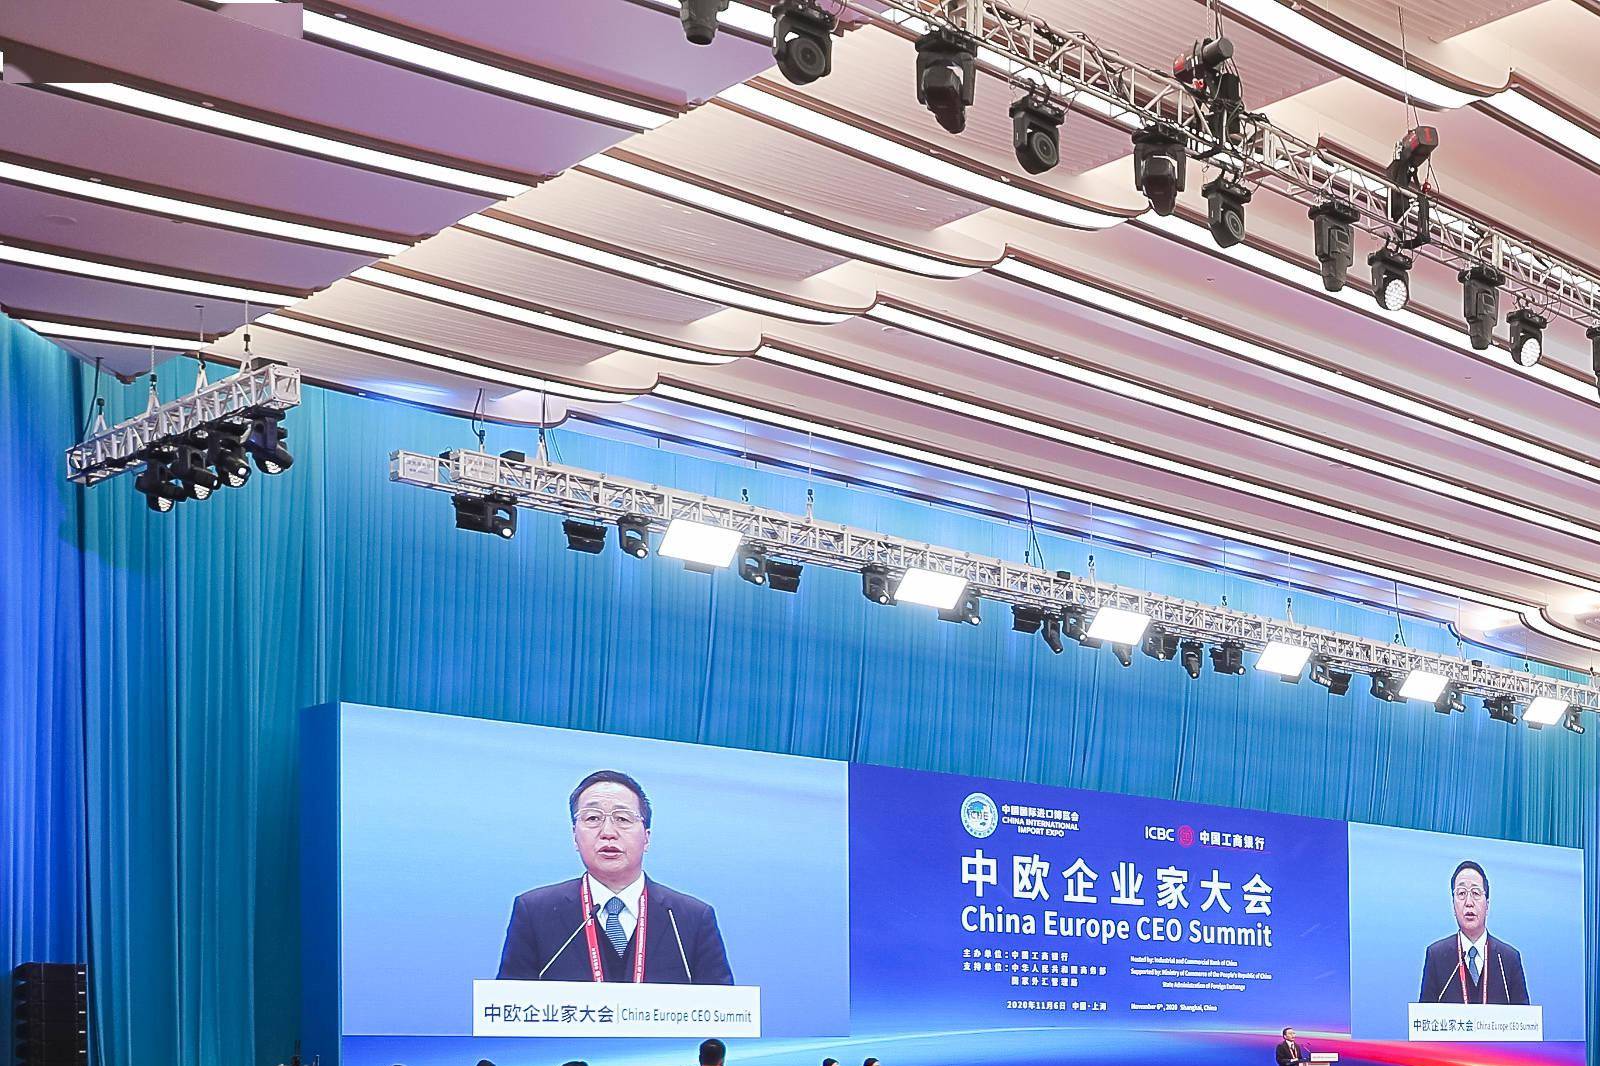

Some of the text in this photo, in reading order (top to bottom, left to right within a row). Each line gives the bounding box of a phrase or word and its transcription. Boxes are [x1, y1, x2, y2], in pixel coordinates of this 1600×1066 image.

[1001, 816, 1080, 831] CHINA INTERNATIONAL
[1017, 825, 1065, 837] IMPORT EXPO
[1144, 825, 1175, 842] ICBC
[1199, 830, 1265, 850] 中国工商银行
[960, 848, 1273, 917] 中欧企业家大会
[960, 905, 1273, 949] China Europe CEO Summit
[483, 1003, 614, 1024] 中欧企业家大会
[621, 1007, 752, 1026] China Europe CEO Summit
[1413, 1018, 1474, 1032] 中欧企业家大会
[1476, 1020, 1491, 1031] China
